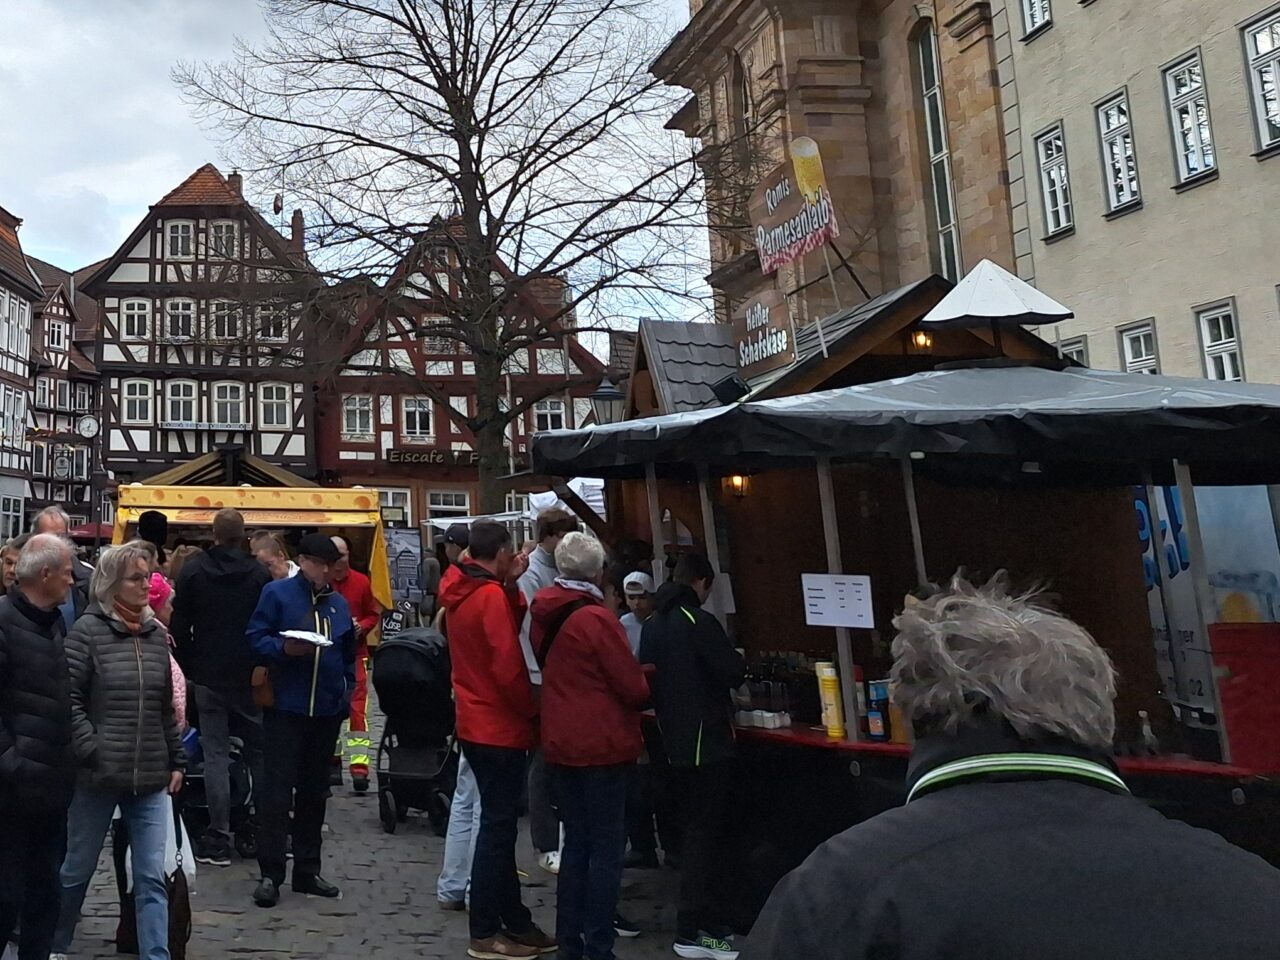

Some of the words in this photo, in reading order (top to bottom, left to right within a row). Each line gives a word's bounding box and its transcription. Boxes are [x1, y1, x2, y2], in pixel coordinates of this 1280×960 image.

[757, 186, 830, 258] Parmesanlaib
[746, 302, 769, 332] Heißer
[739, 327, 788, 368] Schafskäse
[701, 936, 731, 951] FILA
